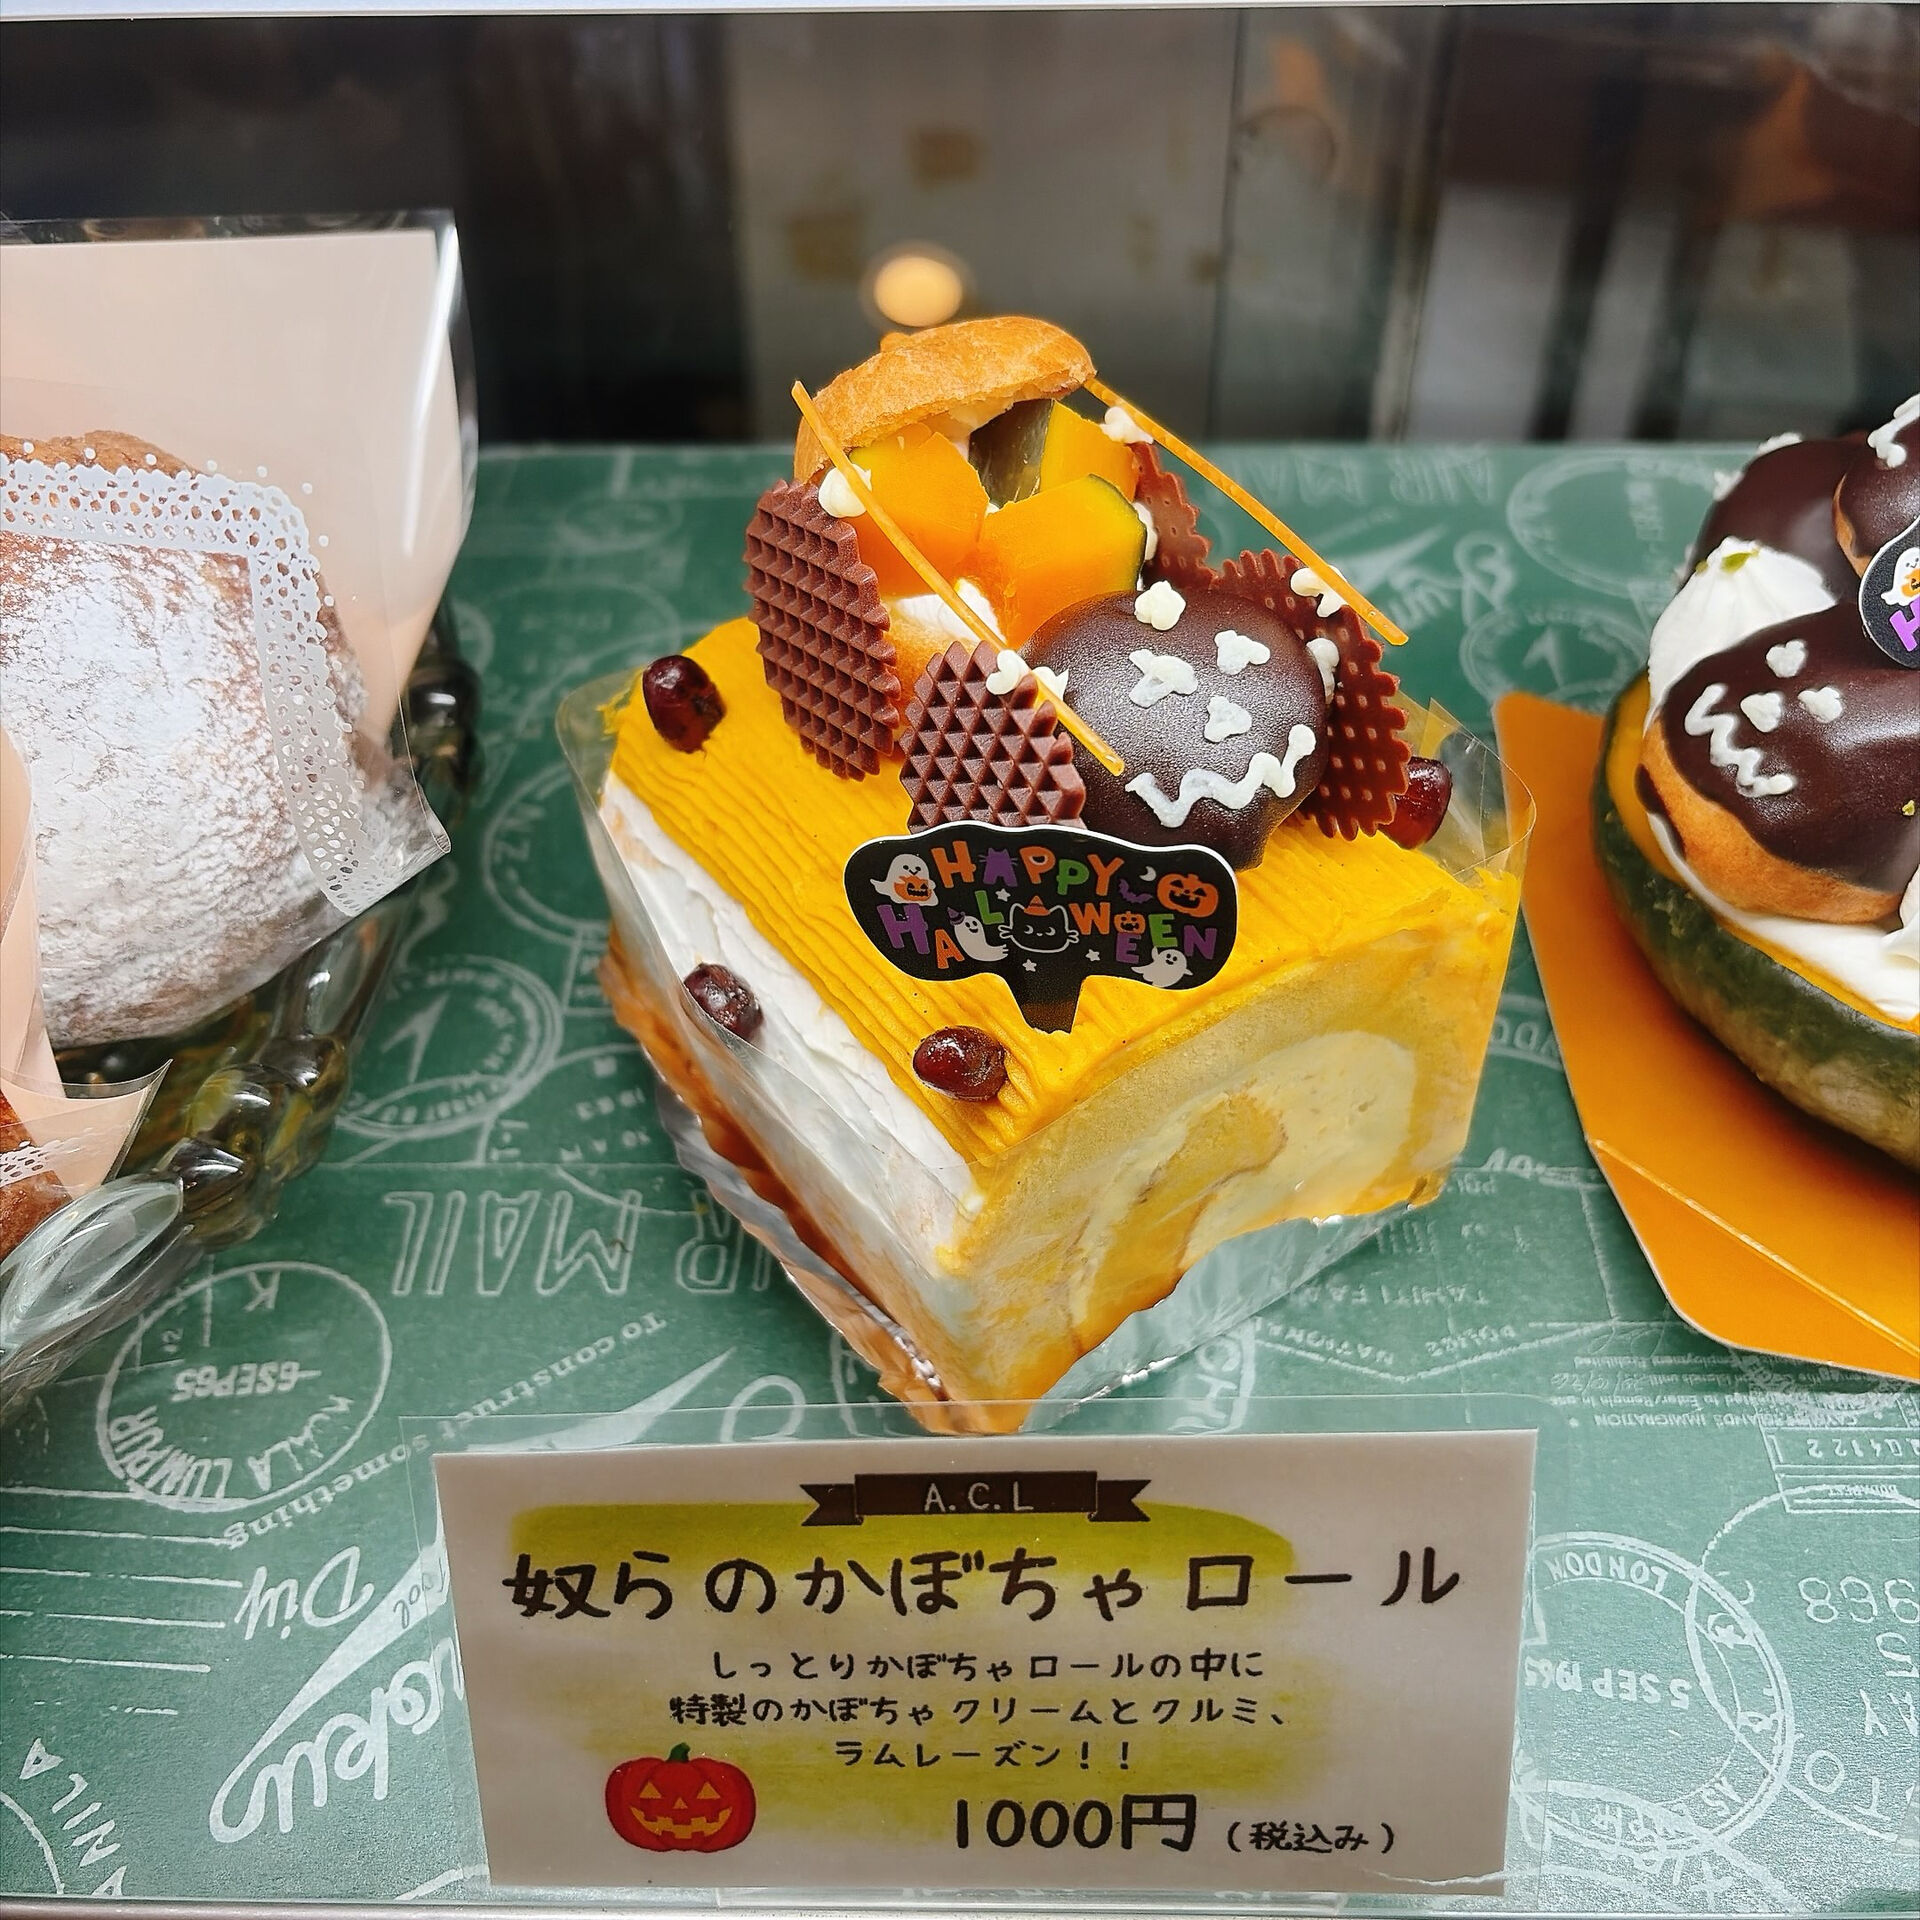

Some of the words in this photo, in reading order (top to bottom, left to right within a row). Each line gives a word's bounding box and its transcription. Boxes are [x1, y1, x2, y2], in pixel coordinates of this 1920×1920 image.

[931, 840, 1125, 896] HAPPY
[382, 1190, 642, 1296] MAIL
[437, 1336, 617, 1442] construct
[1594, 1412, 1706, 1427] IMMIGRATION
[222, 1434, 430, 1551] something
[924, 1482, 1034, 1513] A.C.L
[501, 1546, 1460, 1621] 奴らのかぼちゃロール
[1547, 1550, 1667, 1595] LONDON
[711, 1647, 1266, 1683] しっとりかぼちゃロールの中に
[669, 1692, 1290, 1727] 特製のかぼちゃクリームとクルミ、
[952, 1793, 1198, 1853] 1000円
